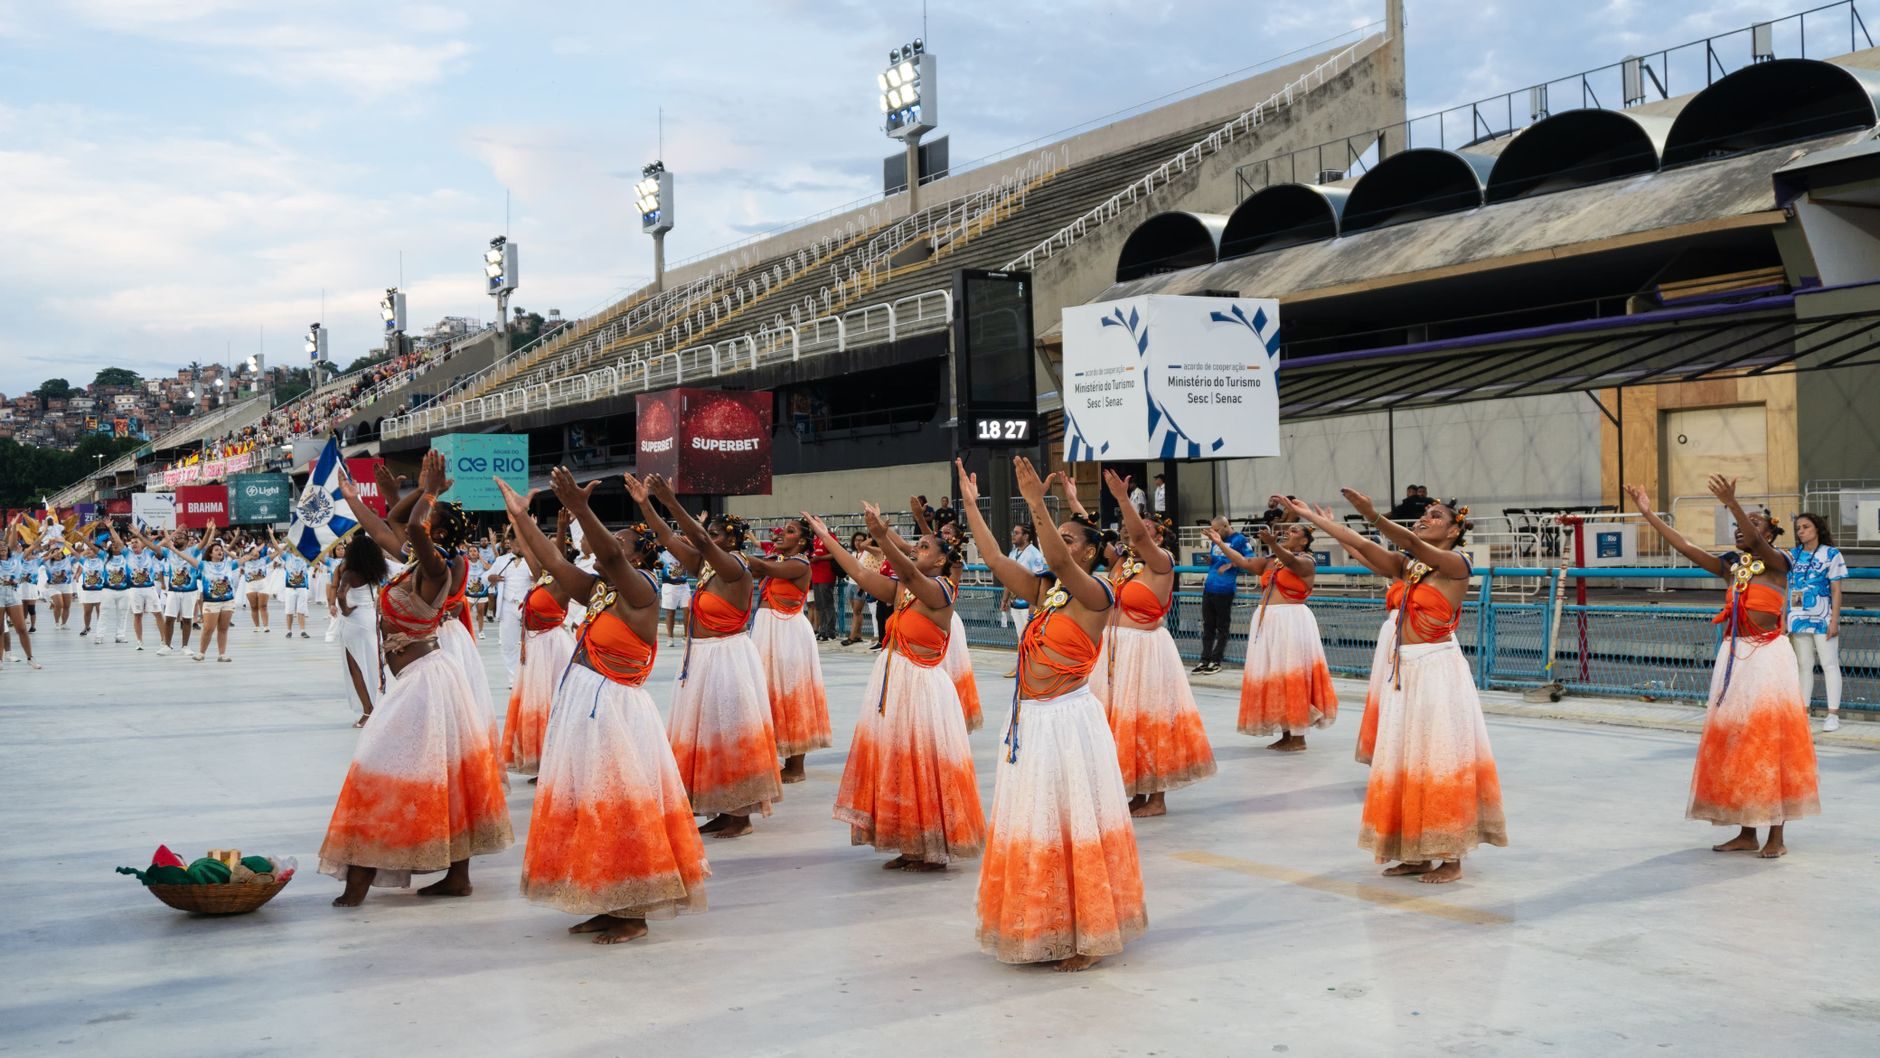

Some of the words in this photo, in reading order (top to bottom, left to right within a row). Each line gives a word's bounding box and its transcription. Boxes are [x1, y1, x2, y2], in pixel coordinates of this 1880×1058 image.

[1183, 361, 1203, 371] acordo
[1204, 361, 1211, 371] de
[1212, 361, 1246, 373] cooperação
[1075, 380, 1103, 394] Ministério
[1104, 381, 1111, 391] do
[1111, 379, 1135, 391] Turismo
[1168, 375, 1212, 387] Ministério
[1213, 376, 1225, 387] do
[1225, 376, 1261, 387] Turismo
[1087, 397, 1101, 409] Sesc
[1105, 396, 1123, 408] Senac
[1187, 392, 1209, 404] Sesc
[1215, 392, 1243, 404] Senac
[979, 420, 1001, 439] 18
[1004, 420, 1027, 439] 27
[641, 437, 673, 453] SUPERBET
[692, 437, 760, 452] SUPERBET
[493, 458, 525, 473] RIO
[259, 486, 279, 496] Light
[188, 502, 224, 513] BRAHMA
